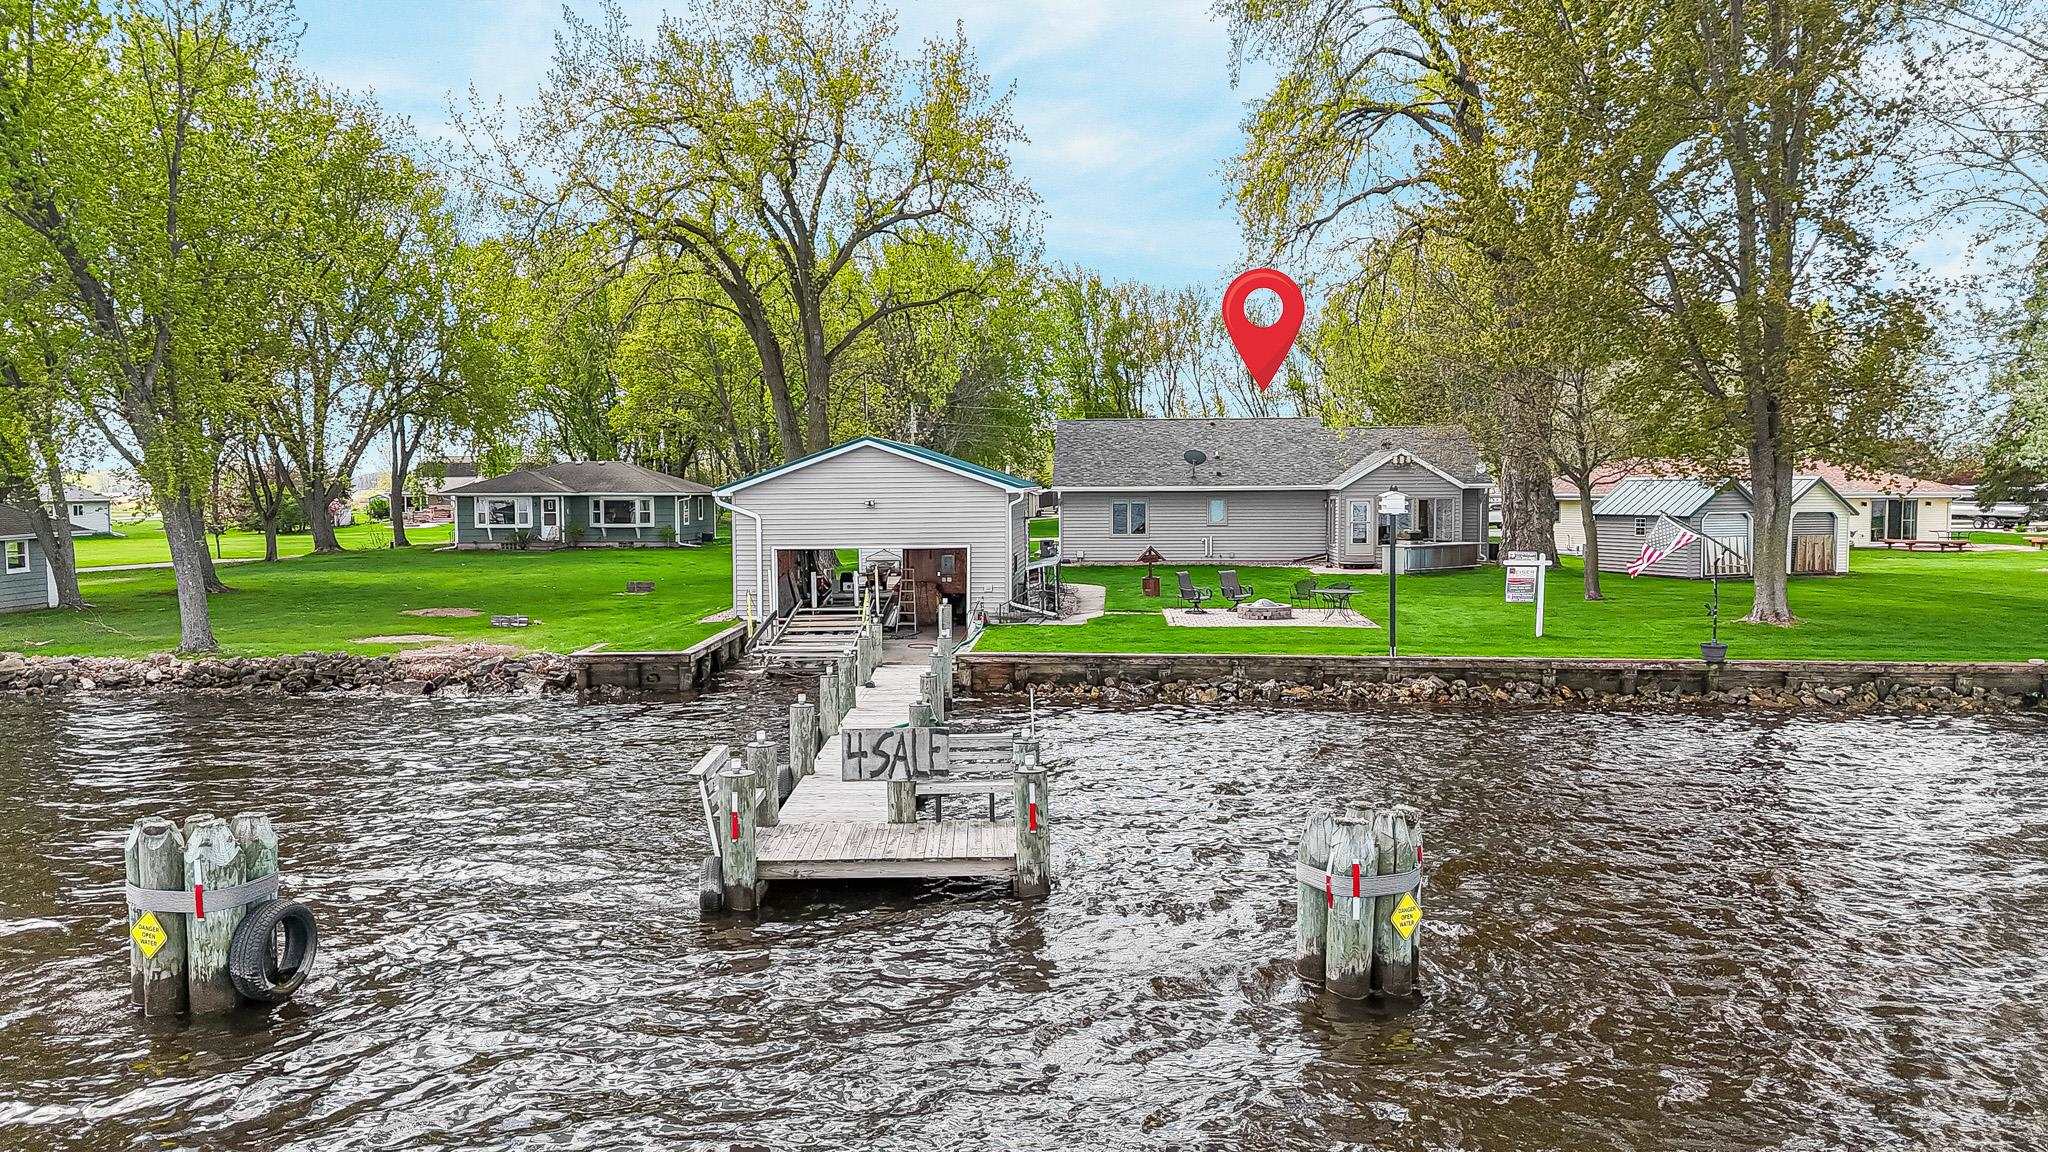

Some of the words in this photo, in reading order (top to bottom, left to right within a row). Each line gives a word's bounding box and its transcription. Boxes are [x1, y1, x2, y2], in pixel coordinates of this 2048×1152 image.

[1398, 906, 1416, 914] DANGER
[138, 924, 160, 932] DANGER
[1400, 920, 1415, 928] WATER
[141, 932, 156, 940] OPEN
[140, 939, 158, 947] WATER
